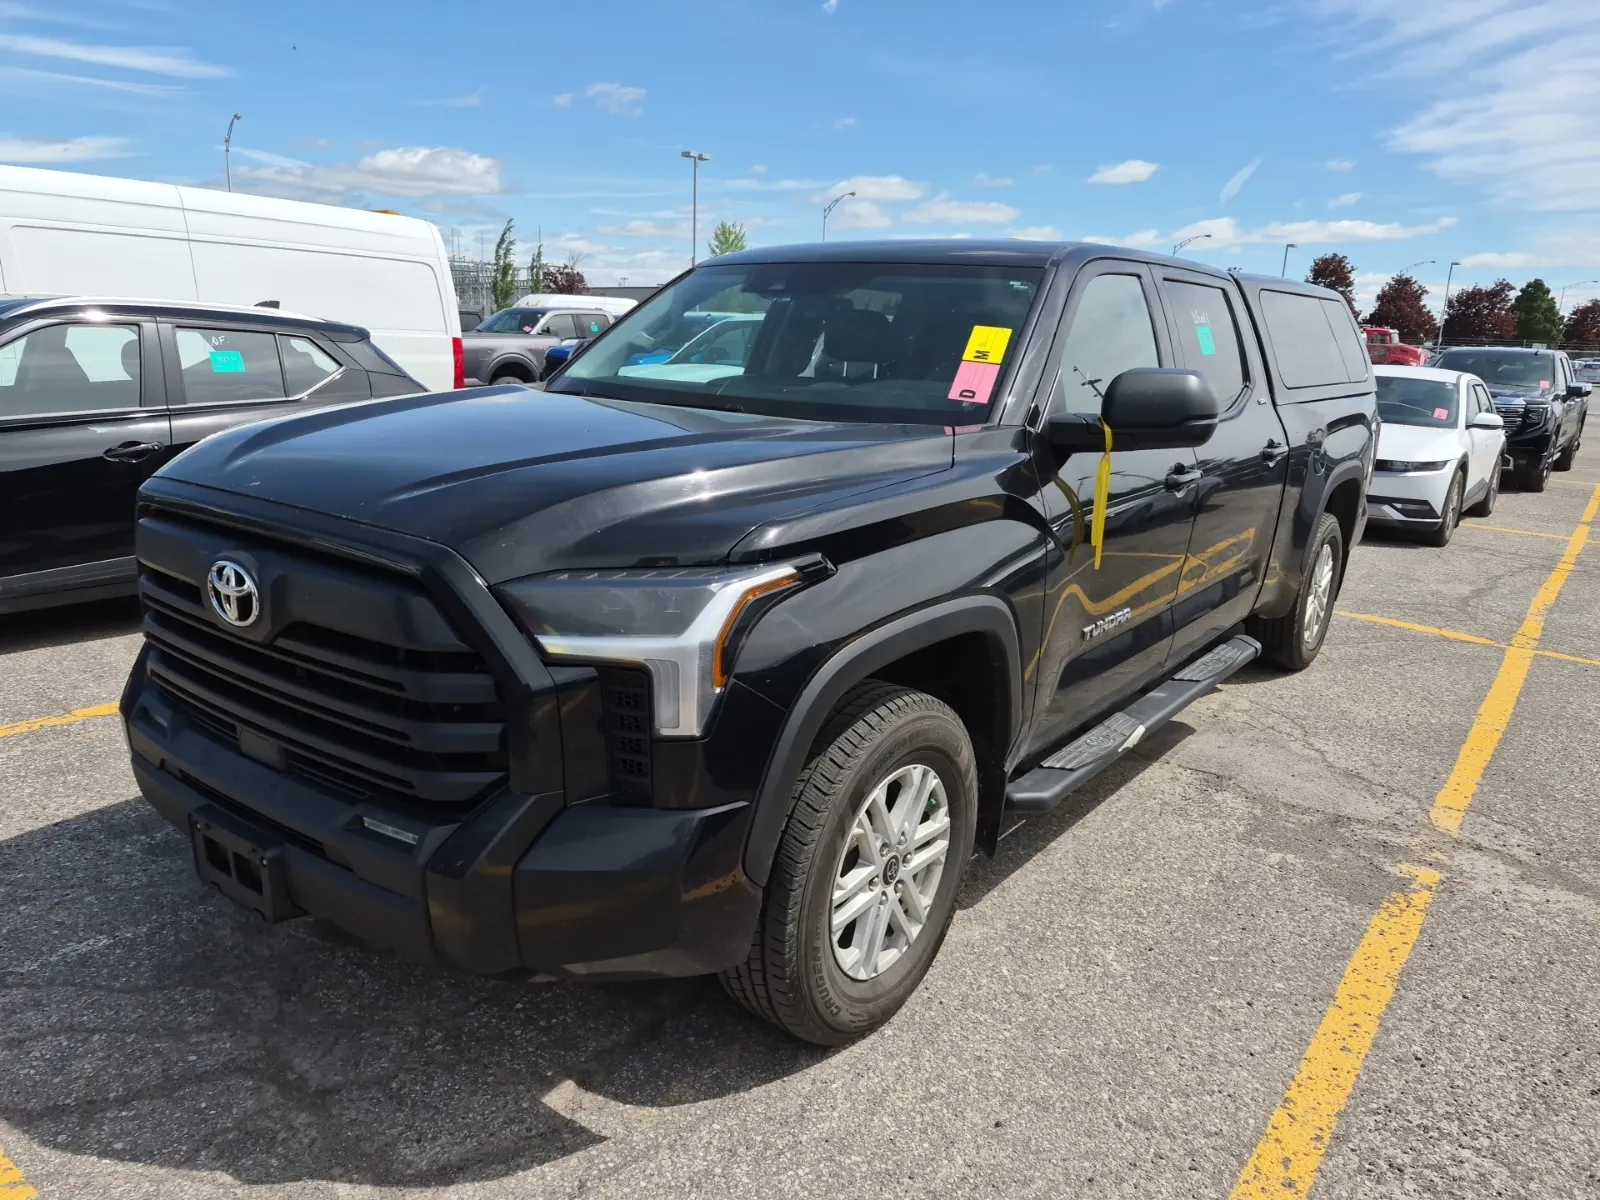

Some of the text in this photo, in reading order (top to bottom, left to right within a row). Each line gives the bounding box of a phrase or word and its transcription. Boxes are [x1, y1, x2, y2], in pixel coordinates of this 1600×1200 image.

[973, 349, 991, 360] M
[959, 389, 977, 399] D
[1082, 607, 1131, 640] TUNDRA
[812, 945, 842, 1018] CRUGEN
